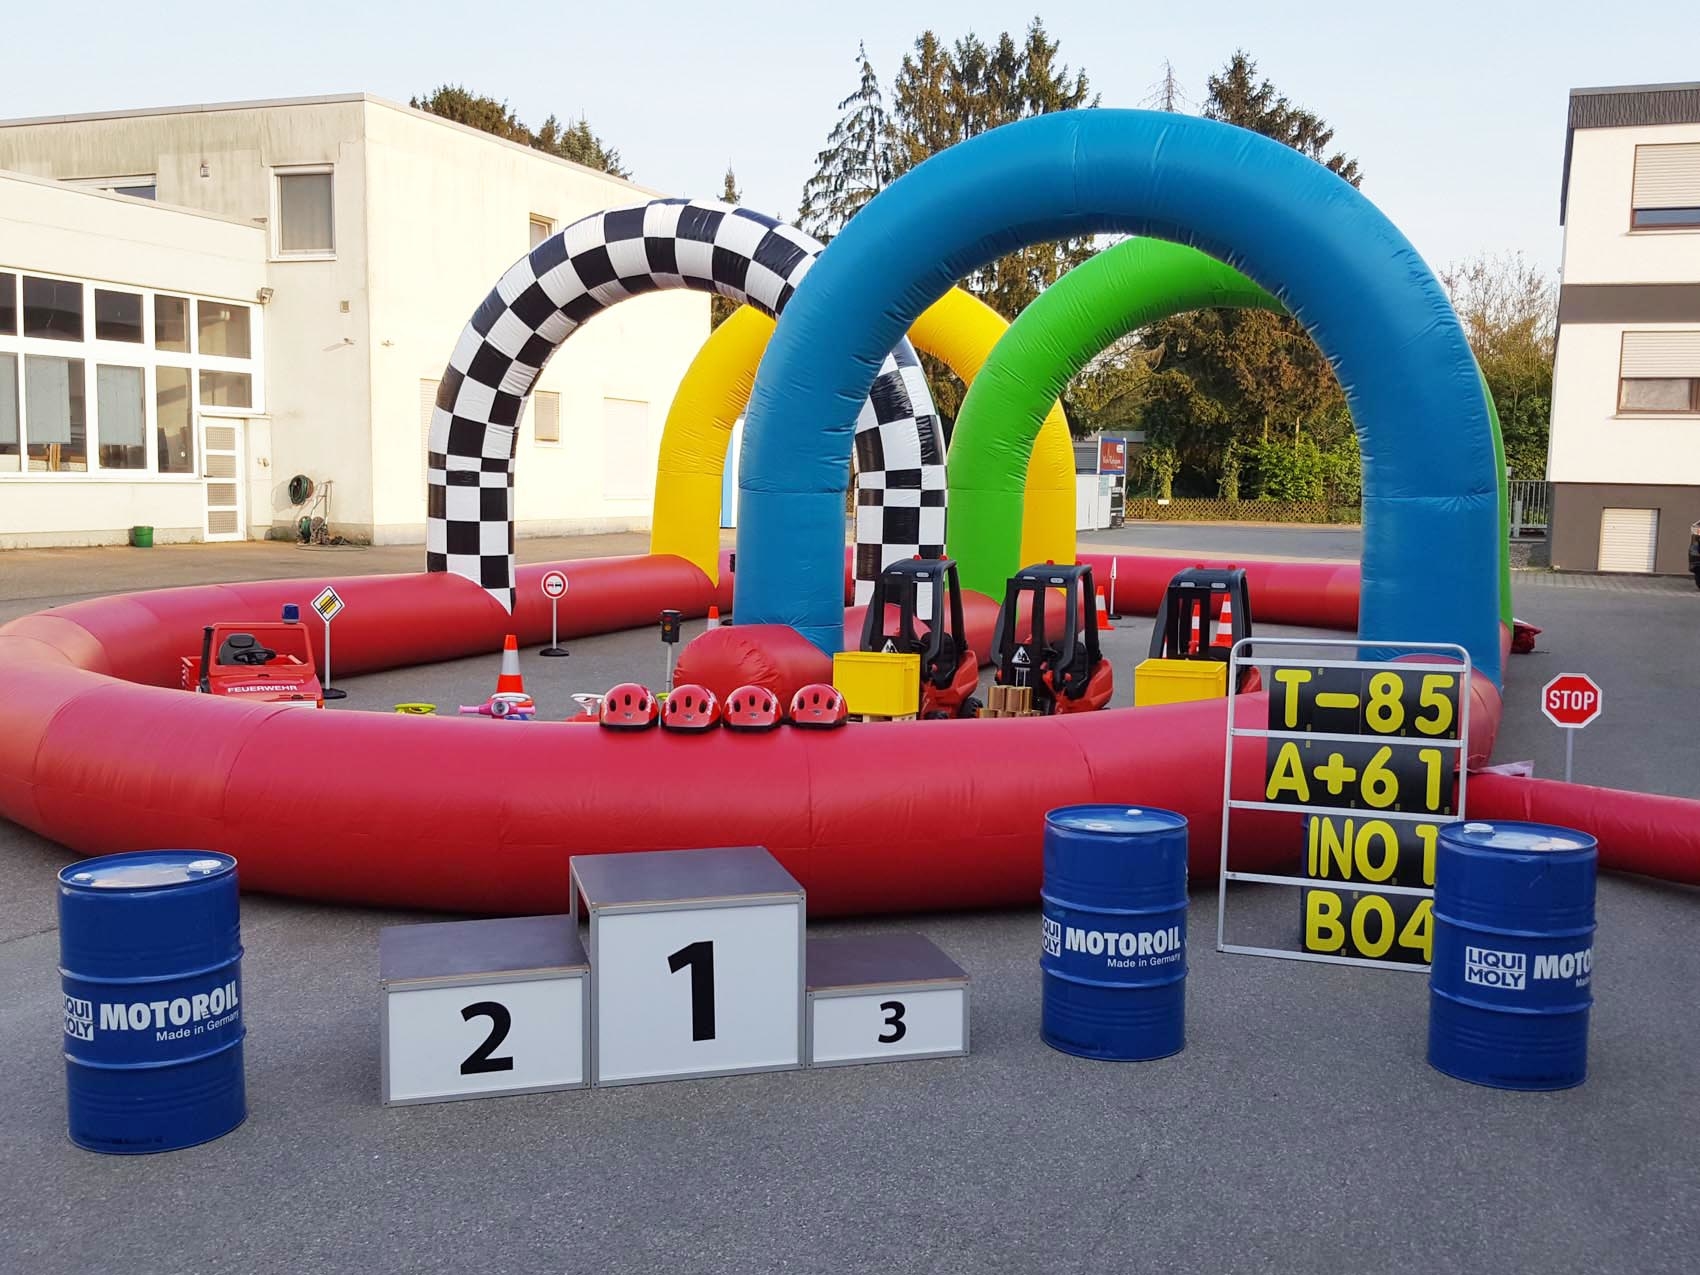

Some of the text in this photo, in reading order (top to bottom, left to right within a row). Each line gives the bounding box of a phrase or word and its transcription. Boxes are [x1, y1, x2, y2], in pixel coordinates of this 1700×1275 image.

[227, 685, 298, 693] FEUERWEHR
[1549, 690, 1595, 710] STOP
[1065, 926, 1181, 957] MOTOROIL
[1107, 952, 1181, 968] Made in Germany
[1468, 948, 1523, 970] LIQUI
[667, 940, 716, 1042] 1
[1467, 966, 1524, 987] MOLY
[100, 980, 239, 1031] MOTOROIL
[156, 1010, 240, 1041] Made in Germany
[460, 1001, 514, 1075] 2
[878, 1001, 908, 1044] 3
